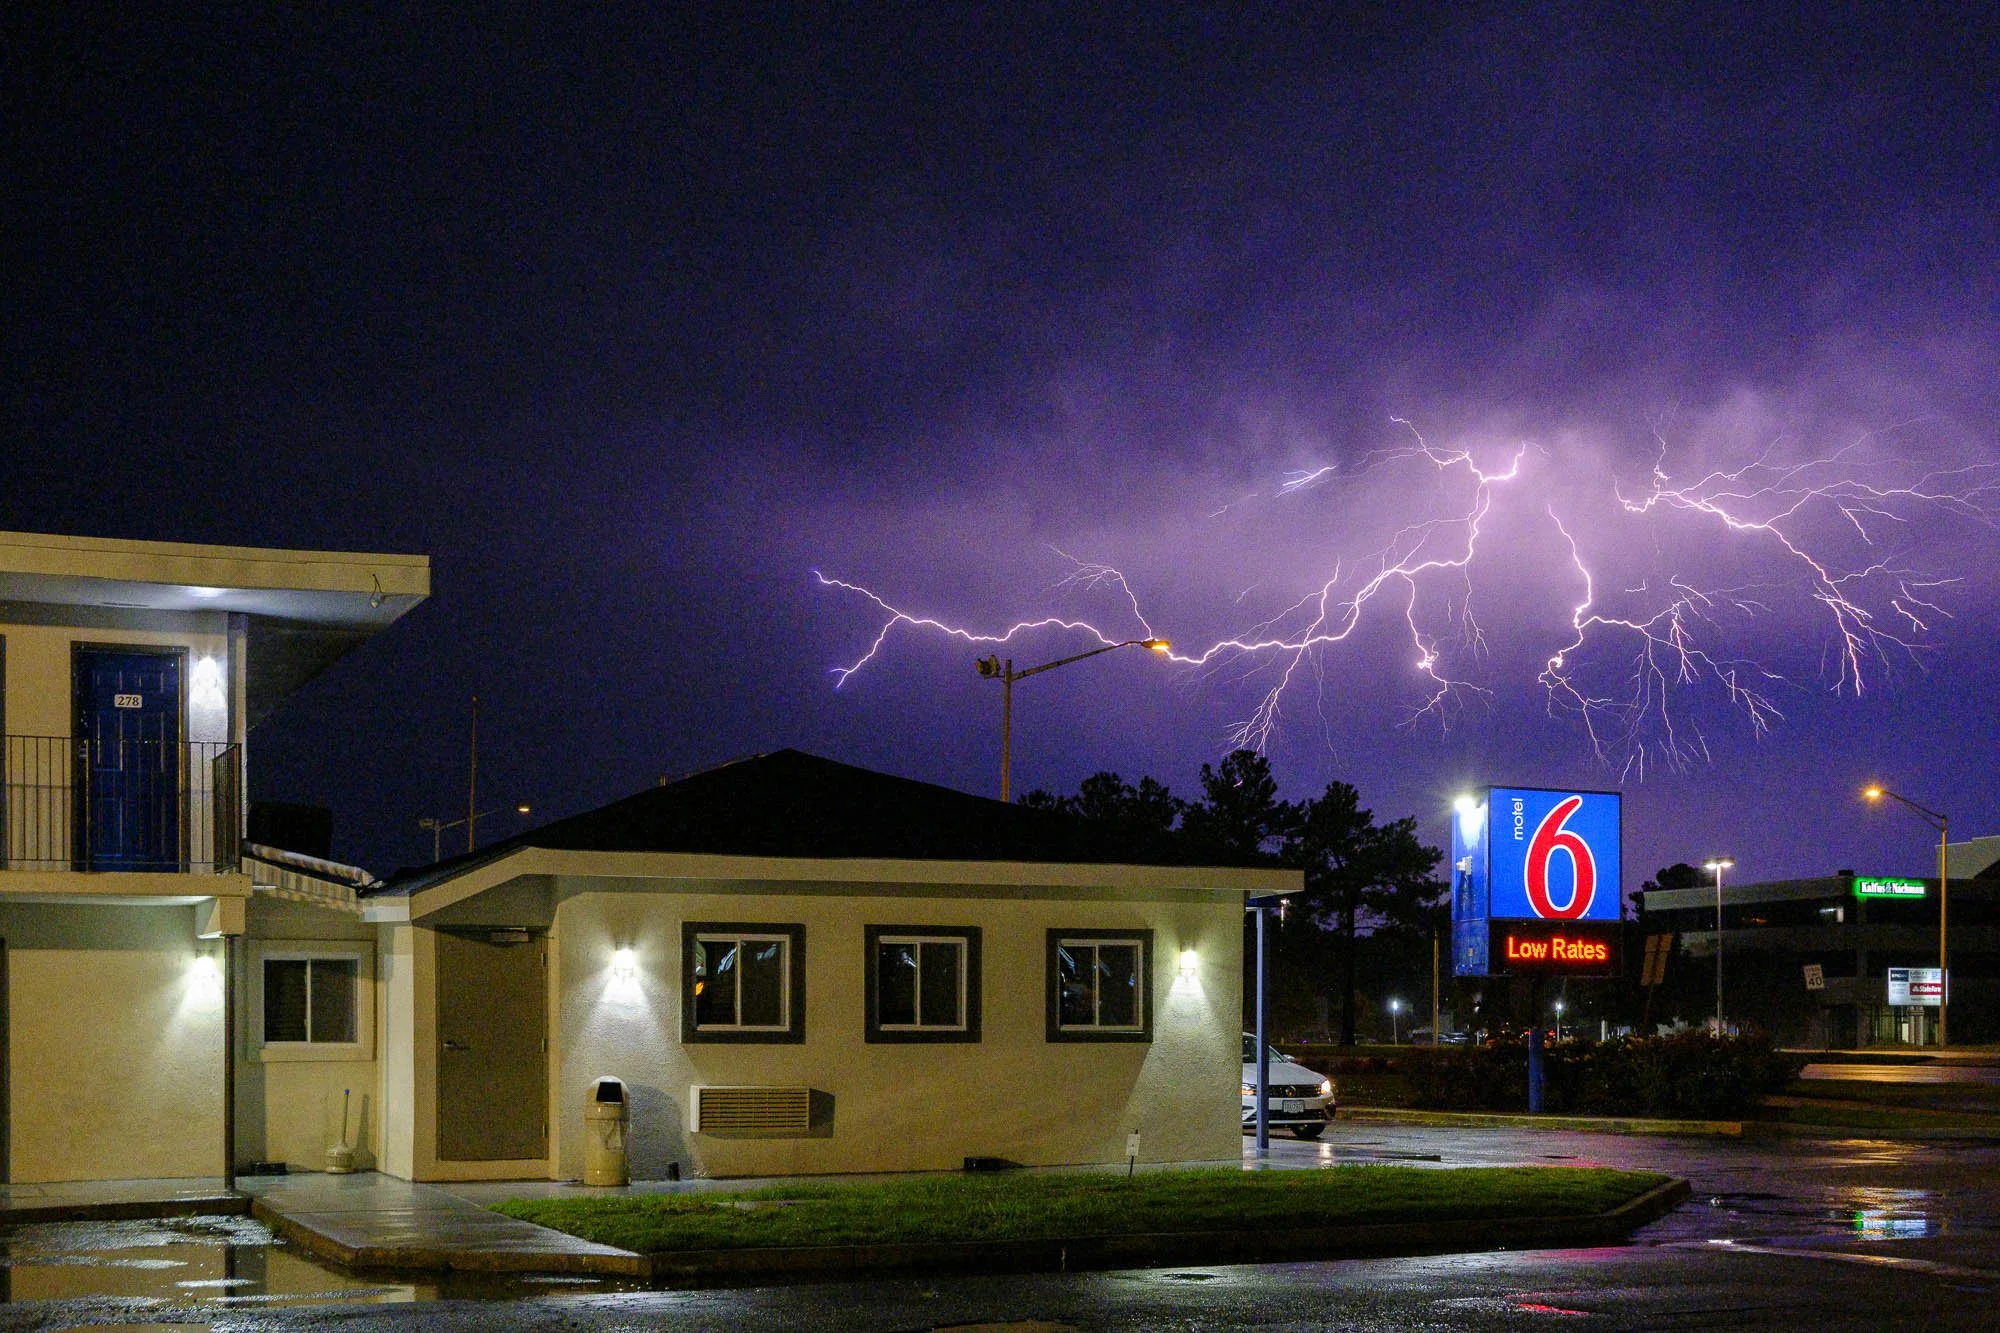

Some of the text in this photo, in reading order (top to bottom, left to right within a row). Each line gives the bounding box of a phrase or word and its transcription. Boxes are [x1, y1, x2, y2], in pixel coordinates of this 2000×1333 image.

[118, 696, 139, 706] 278
[1511, 798, 1524, 840] motel
[1524, 795, 1597, 920] 6
[1508, 936, 1608, 960] Low Rates
[1809, 976, 1823, 986] 40
